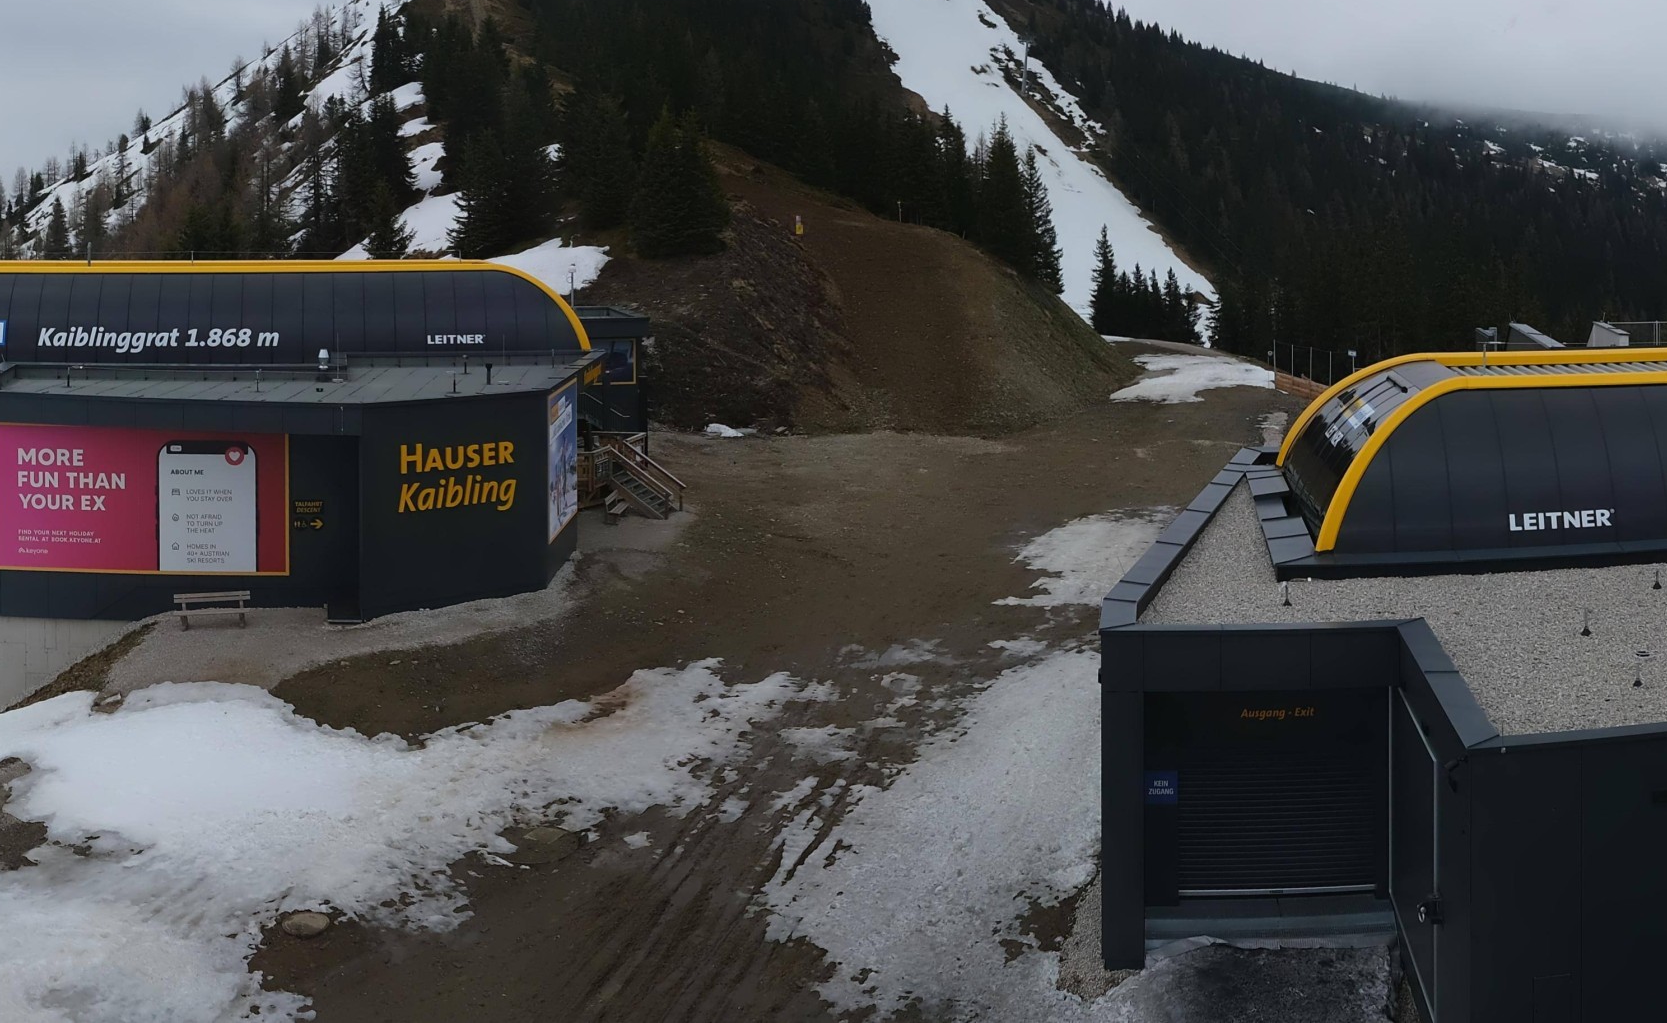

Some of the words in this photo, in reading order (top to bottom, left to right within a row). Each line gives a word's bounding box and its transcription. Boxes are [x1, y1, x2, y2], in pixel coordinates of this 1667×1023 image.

[38, 326, 179, 353] Kaiblinggrat
[185, 327, 251, 347] 1.868
[256, 332, 280, 347] m
[17, 448, 84, 466] MORE
[400, 441, 515, 474] HAUSER
[17, 471, 59, 488] FUN
[66, 472, 126, 489] THAN
[19, 493, 74, 510] YOUR
[81, 495, 106, 511] EX
[398, 475, 517, 513] Kaibling
[1240, 708, 1285, 721] Ausgang
[1294, 707, 1315, 717] Exit
